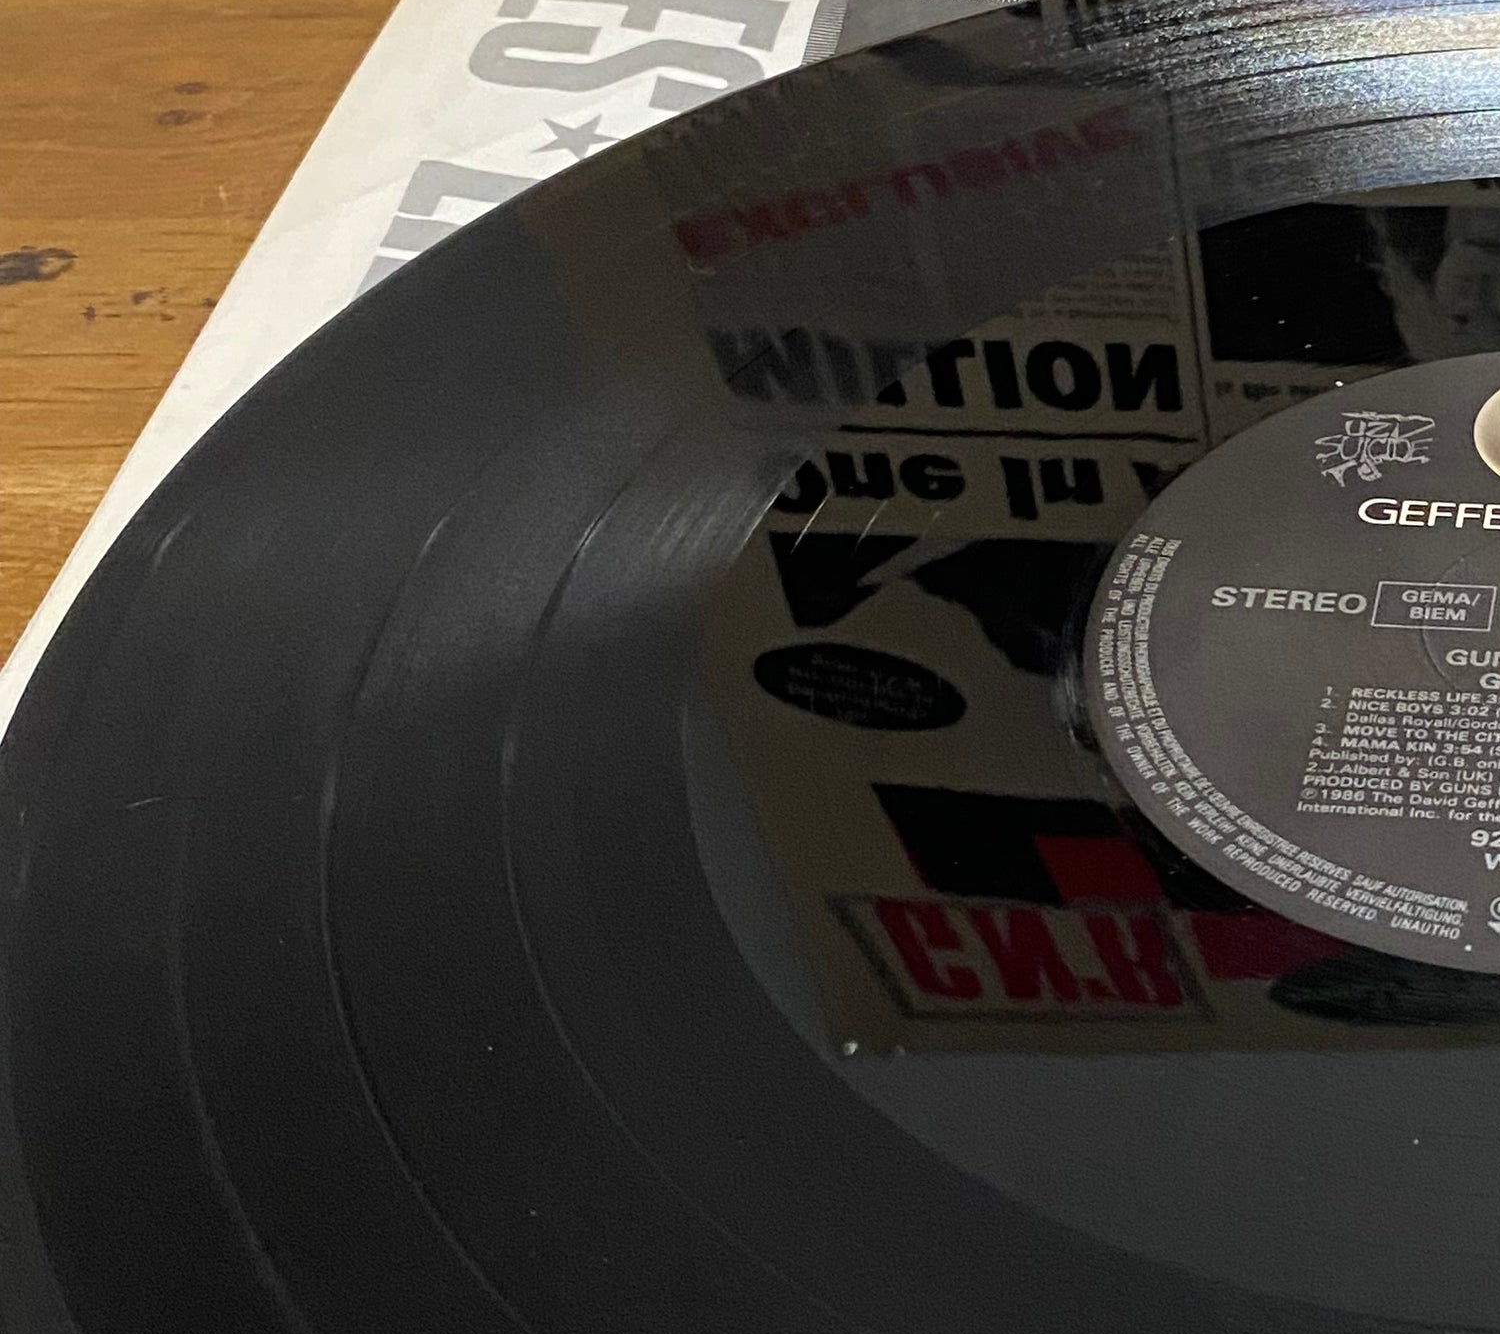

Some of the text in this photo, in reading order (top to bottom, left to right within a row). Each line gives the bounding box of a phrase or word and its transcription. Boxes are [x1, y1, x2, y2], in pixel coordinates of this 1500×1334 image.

[1211, 585, 1482, 615] STEREO GEMA/
[1409, 604, 1467, 623] BIEM
[1480, 674, 1500, 691] G
